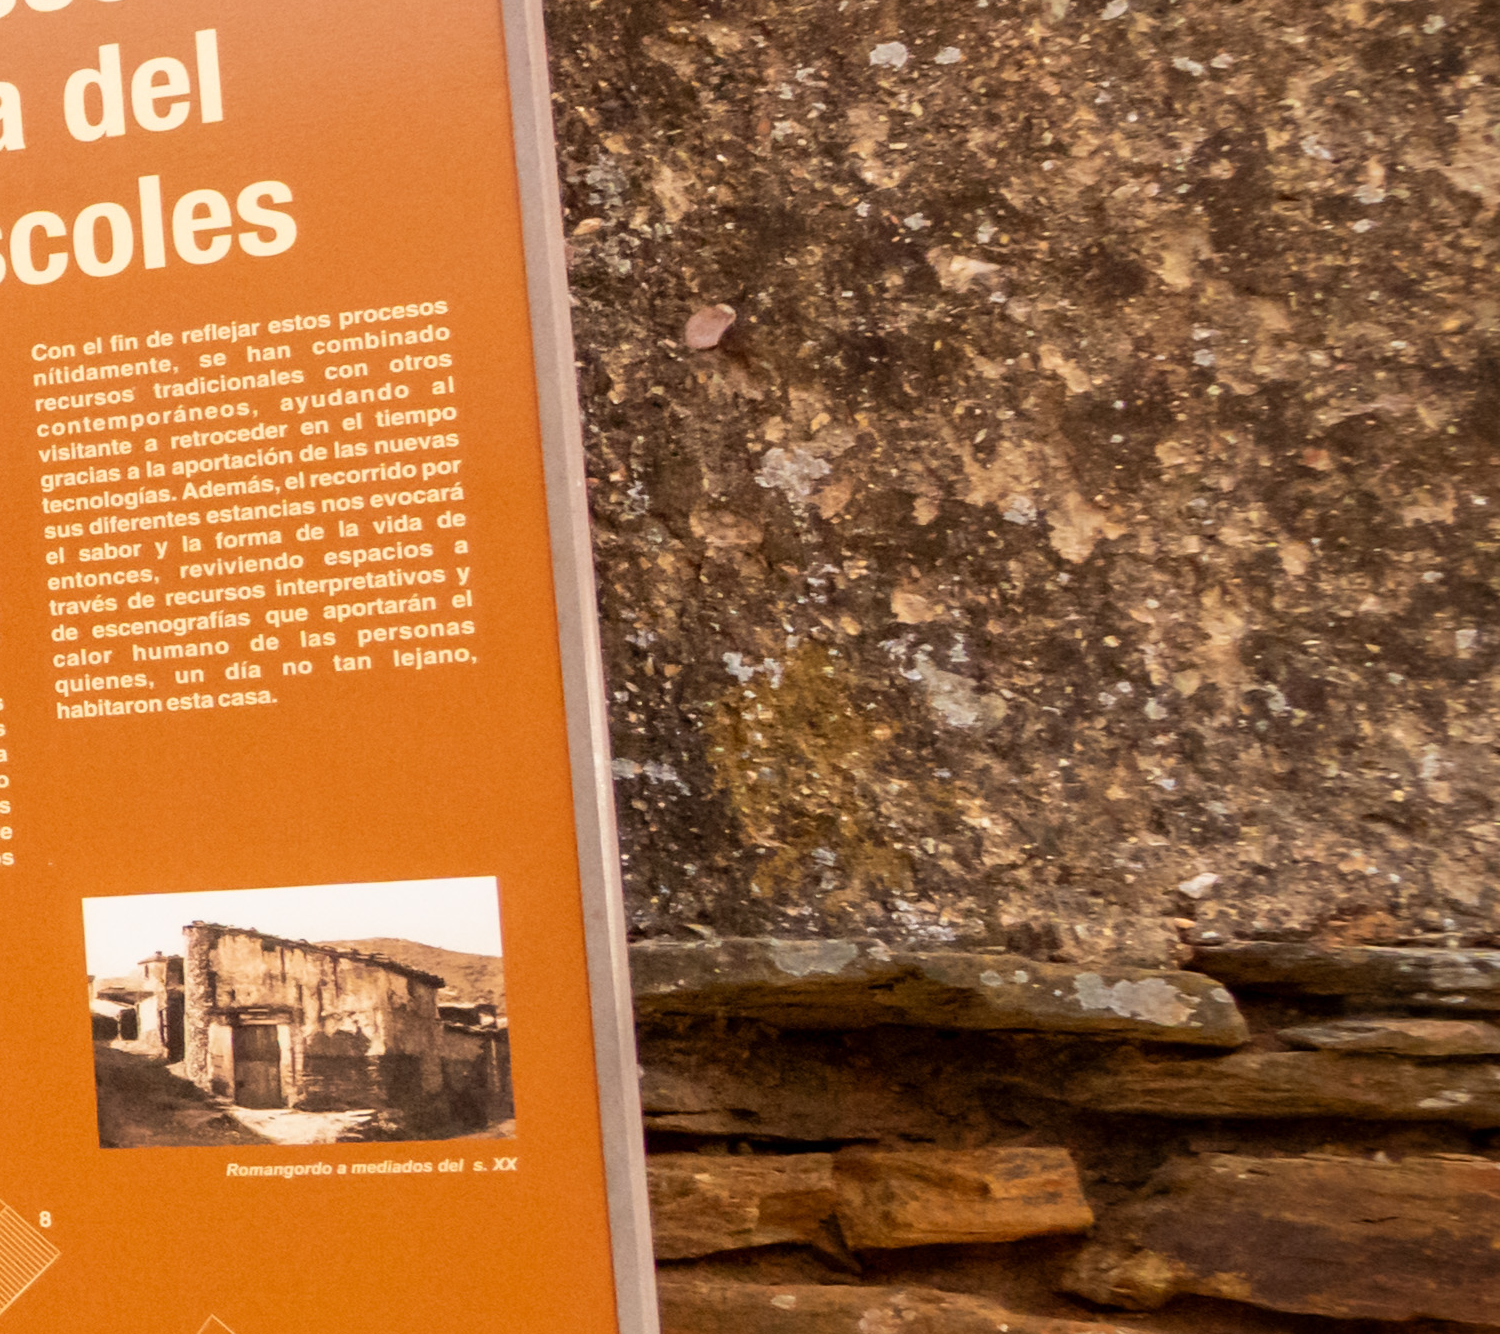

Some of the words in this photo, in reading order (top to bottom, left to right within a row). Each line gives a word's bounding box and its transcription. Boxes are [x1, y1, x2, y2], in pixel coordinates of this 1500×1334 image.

[64, 29, 223, 141] del
[31, 343, 76, 362] Con
[82, 336, 103, 356] el
[109, 334, 139, 353] fin
[145, 330, 174, 349] de
[181, 321, 261, 345] reflejar
[267, 314, 332, 335] estos
[338, 300, 449, 331] procesos
[33, 357, 179, 387] nítidamente,
[199, 352, 227, 369] se
[246, 345, 292, 363] han
[312, 324, 451, 356] combinado
[35, 388, 135, 412] recursos
[152, 369, 305, 399] tradicionales
[324, 362, 369, 381] con
[389, 353, 453, 373] otros
[36, 402, 258, 438] contemporáneos,
[280, 382, 410, 415] ayudando
[431, 375, 455, 395] al
[56, 698, 164, 720] habitaron
[165, 692, 215, 712] esta
[217, 690, 278, 708] casa.
[227, 1162, 332, 1178] Romangordo
[337, 1164, 346, 1174] a
[351, 1160, 432, 1173] mediados
[438, 1159, 463, 1172] del
[473, 1161, 487, 1171] s.
[493, 1158, 517, 1170] XX
[40, 1211, 51, 1227] 8
